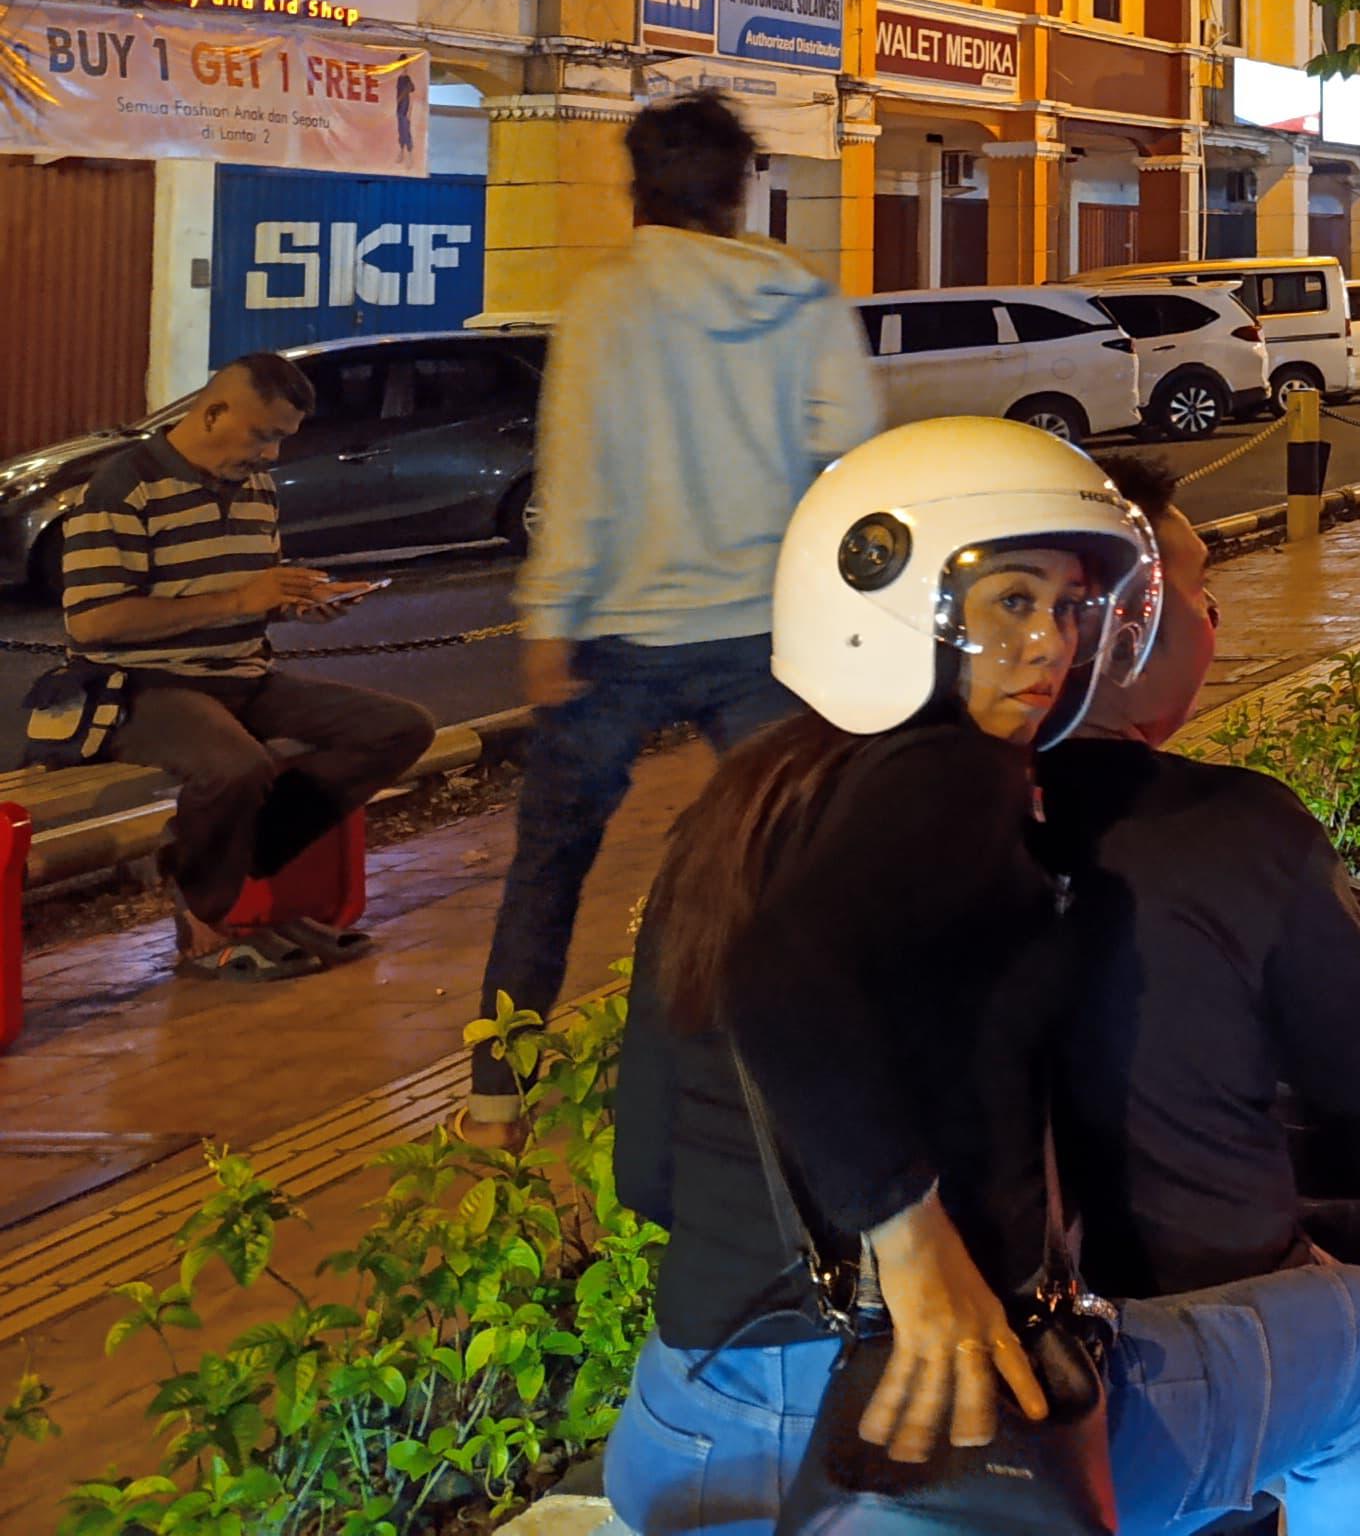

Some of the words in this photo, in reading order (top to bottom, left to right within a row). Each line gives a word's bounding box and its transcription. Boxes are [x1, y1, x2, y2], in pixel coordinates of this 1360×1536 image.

[307, 0, 360, 27] Shop
[745, 30, 795, 52] Authorized
[797, 39, 841, 59] Distributor
[876, 21, 943, 63] WALET
[946, 34, 1014, 75] MEDIKA
[46, 26, 135, 79] BUY
[153, 37, 170, 81] 1
[191, 41, 263, 94] GET
[278, 52, 291, 94] 1
[306, 54, 380, 104] FREE
[116, 96, 169, 116] Semua
[174, 99, 230, 119] Fashion
[234, 106, 265, 123] Anak
[268, 109, 288, 125] dan
[292, 110, 330, 129] Sepatu
[201, 126, 214, 140] di
[220, 129, 257, 143] Lantai
[263, 129, 271, 144] 2
[245, 221, 473, 310] SKF
